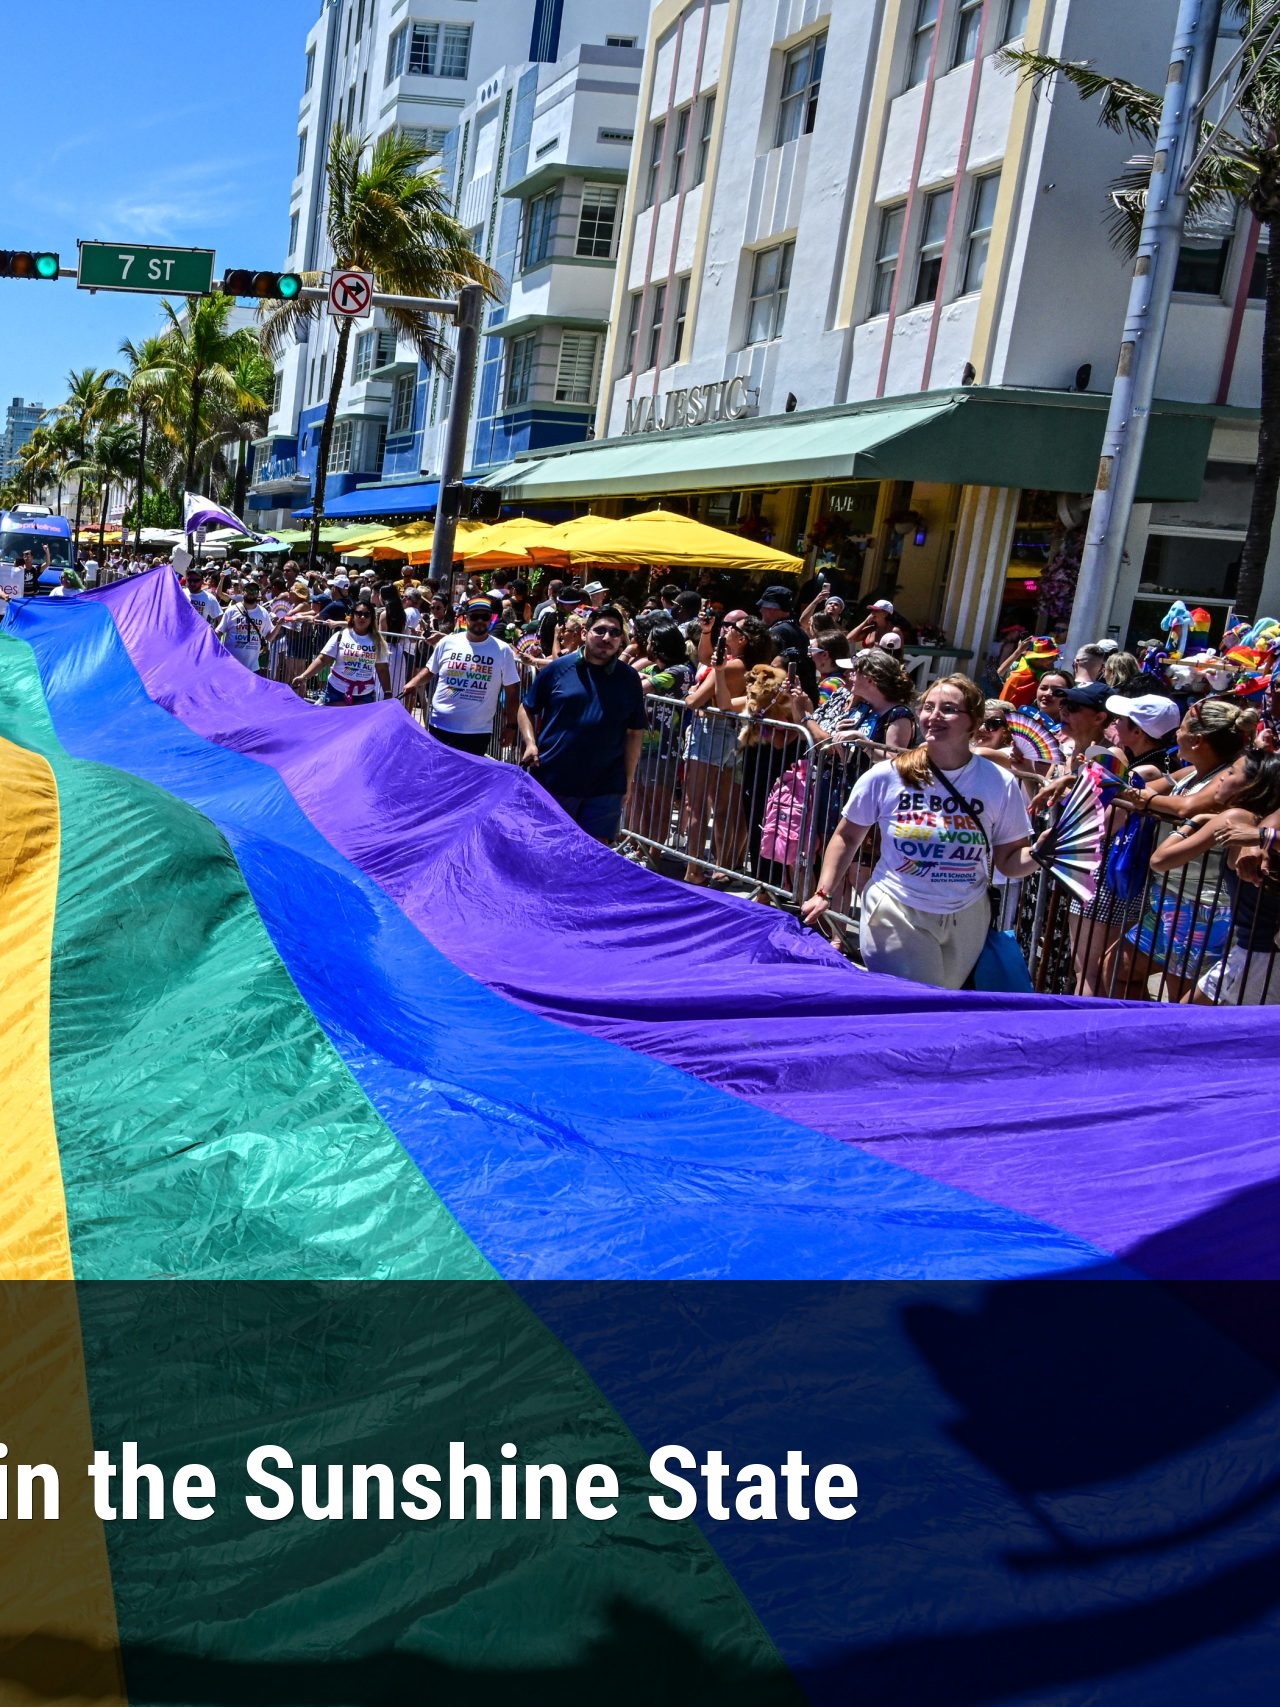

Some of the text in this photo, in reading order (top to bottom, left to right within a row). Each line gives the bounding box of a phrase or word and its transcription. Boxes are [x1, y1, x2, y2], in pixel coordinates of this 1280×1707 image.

[118, 254, 176, 281] 7 ST
[622, 376, 751, 436] MAJESTIC
[344, 649, 359, 657] LIVE
[345, 642, 356, 650] BE
[450, 652, 494, 666] BE BOLD
[447, 661, 493, 675] LIVE FREE
[446, 676, 488, 690] LOVE ALL
[466, 671, 492, 682] WOKE
[898, 793, 925, 811] BE
[897, 810, 937, 828] LIVE
[894, 824, 935, 841] STAY
[893, 838, 984, 862] LOVE ALL
